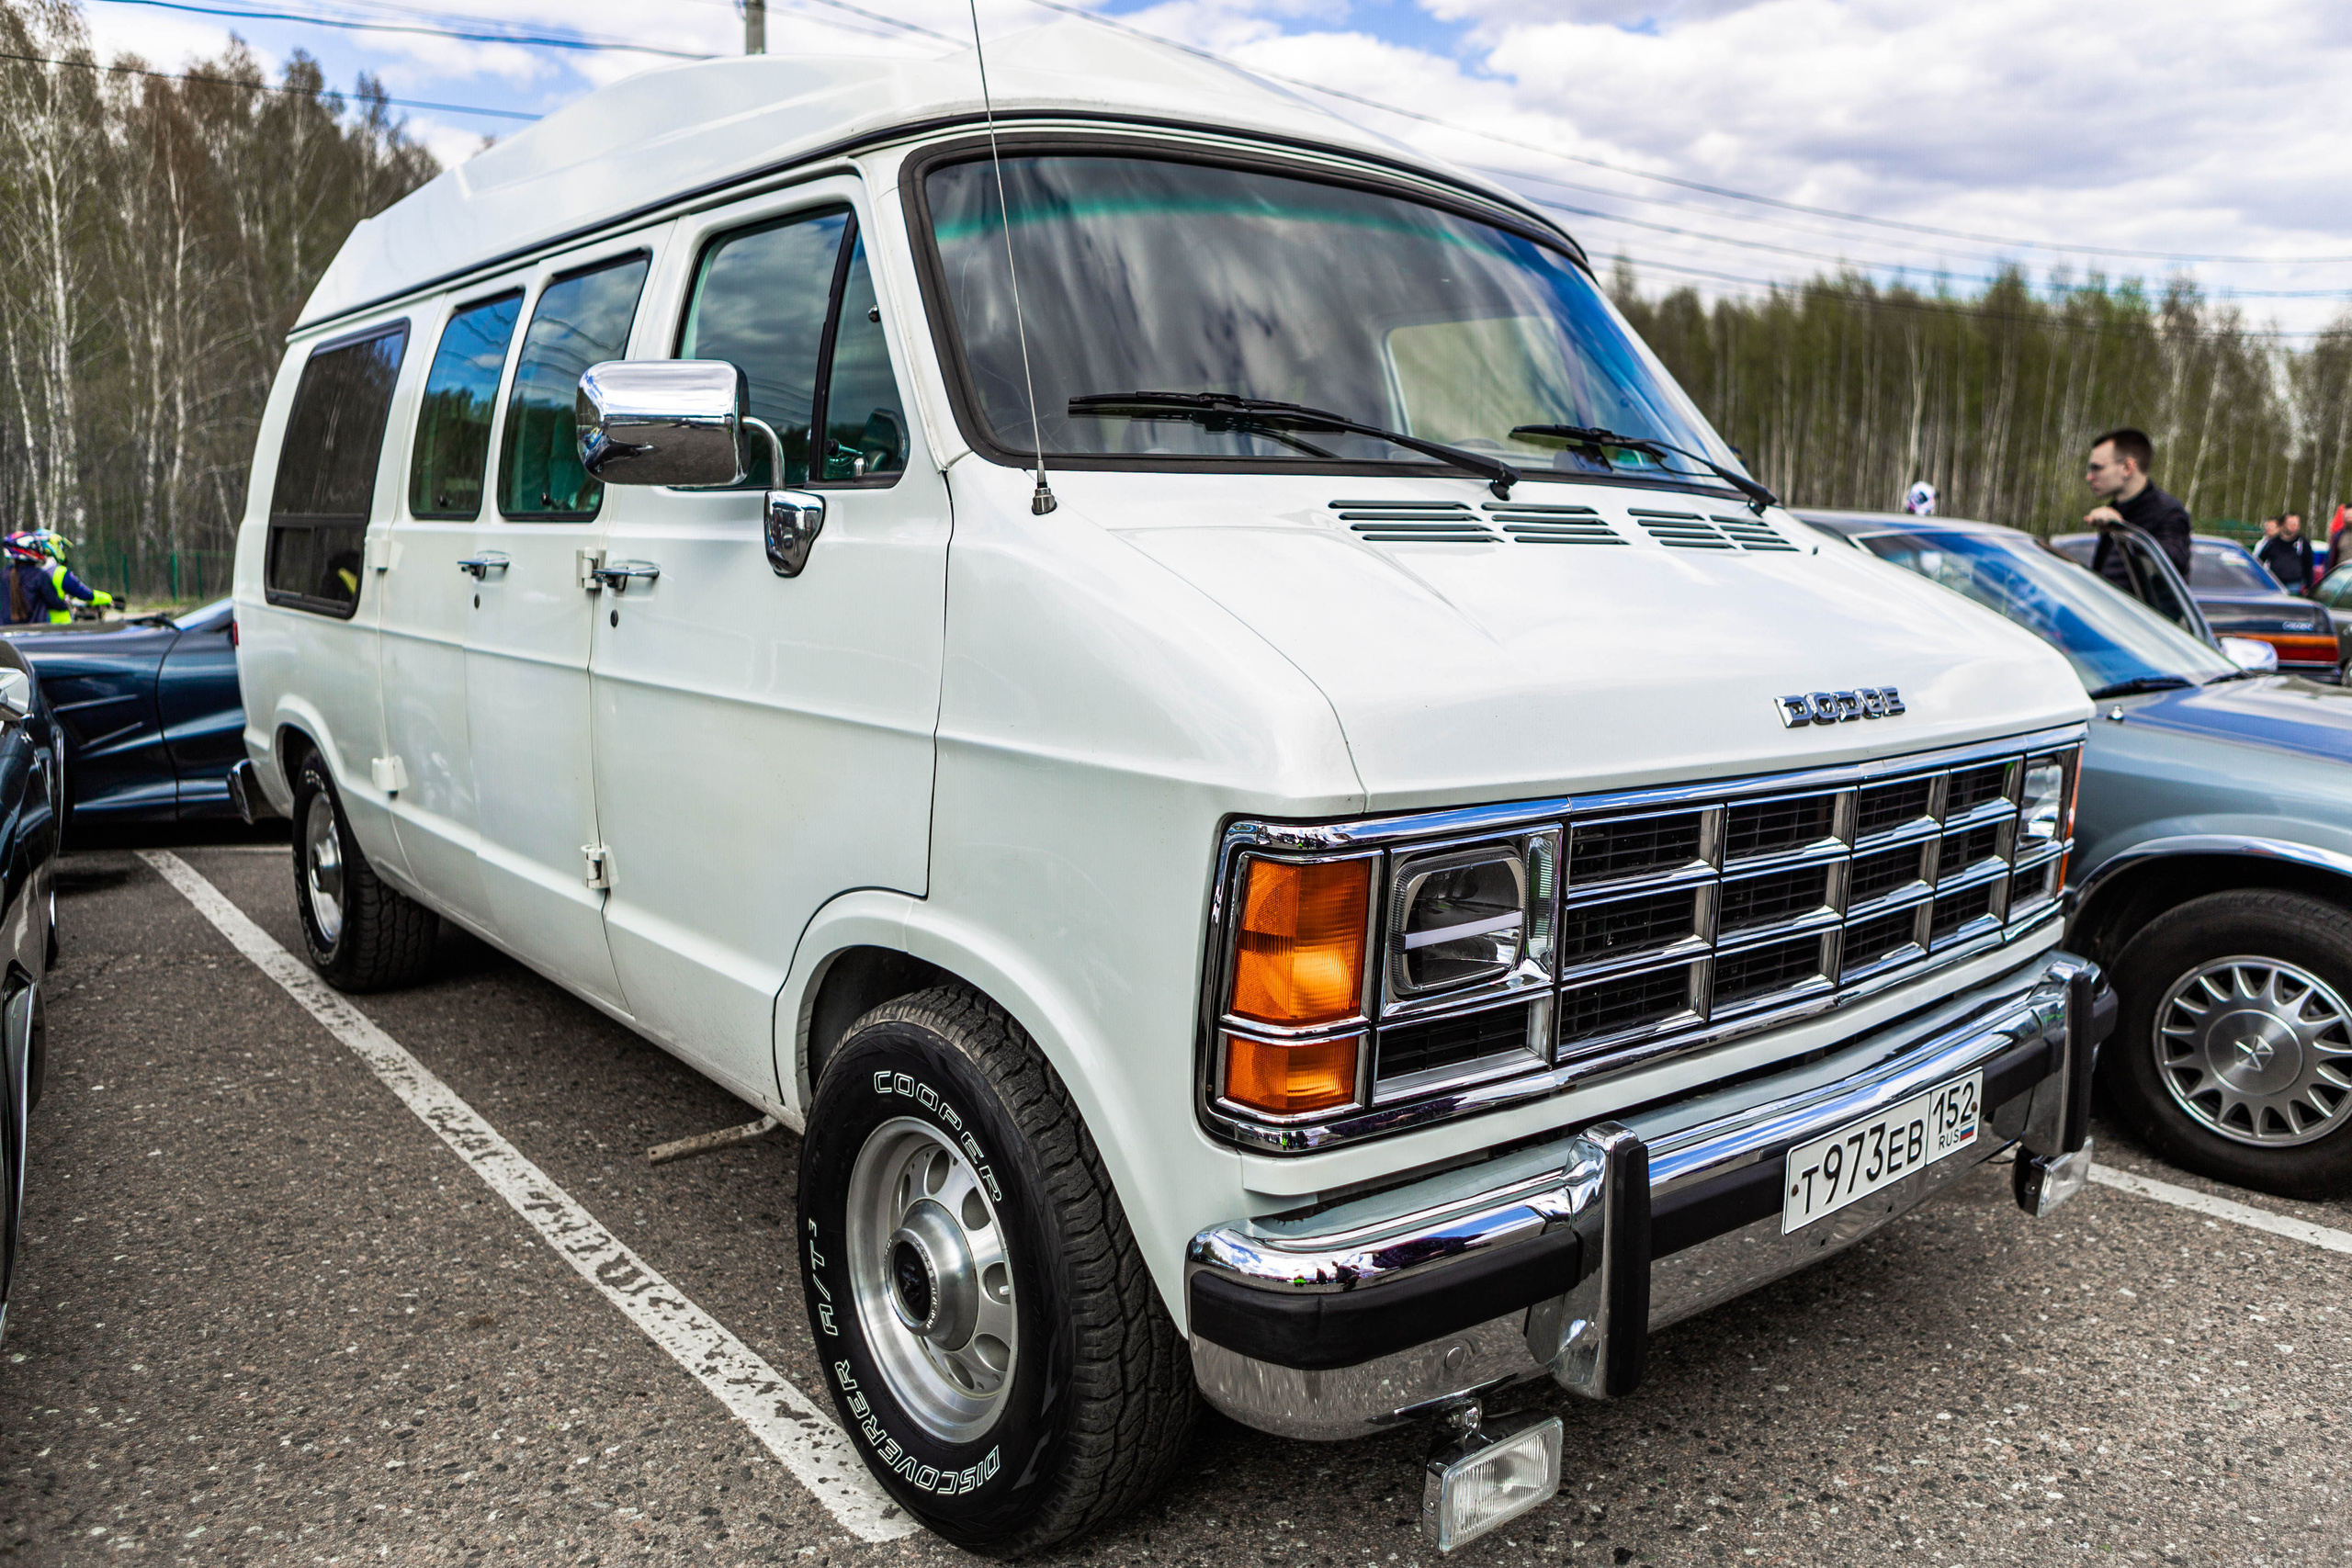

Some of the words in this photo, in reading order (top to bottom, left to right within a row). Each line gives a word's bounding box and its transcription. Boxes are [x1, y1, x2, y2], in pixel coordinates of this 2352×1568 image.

[1773, 686, 1905, 728] DODGE
[1932, 1080, 1974, 1134] 152
[874, 1069, 1002, 1202] COOPER
[1938, 1128, 1960, 1151] RUS
[834, 1359, 1001, 1495] DISCOVERER
